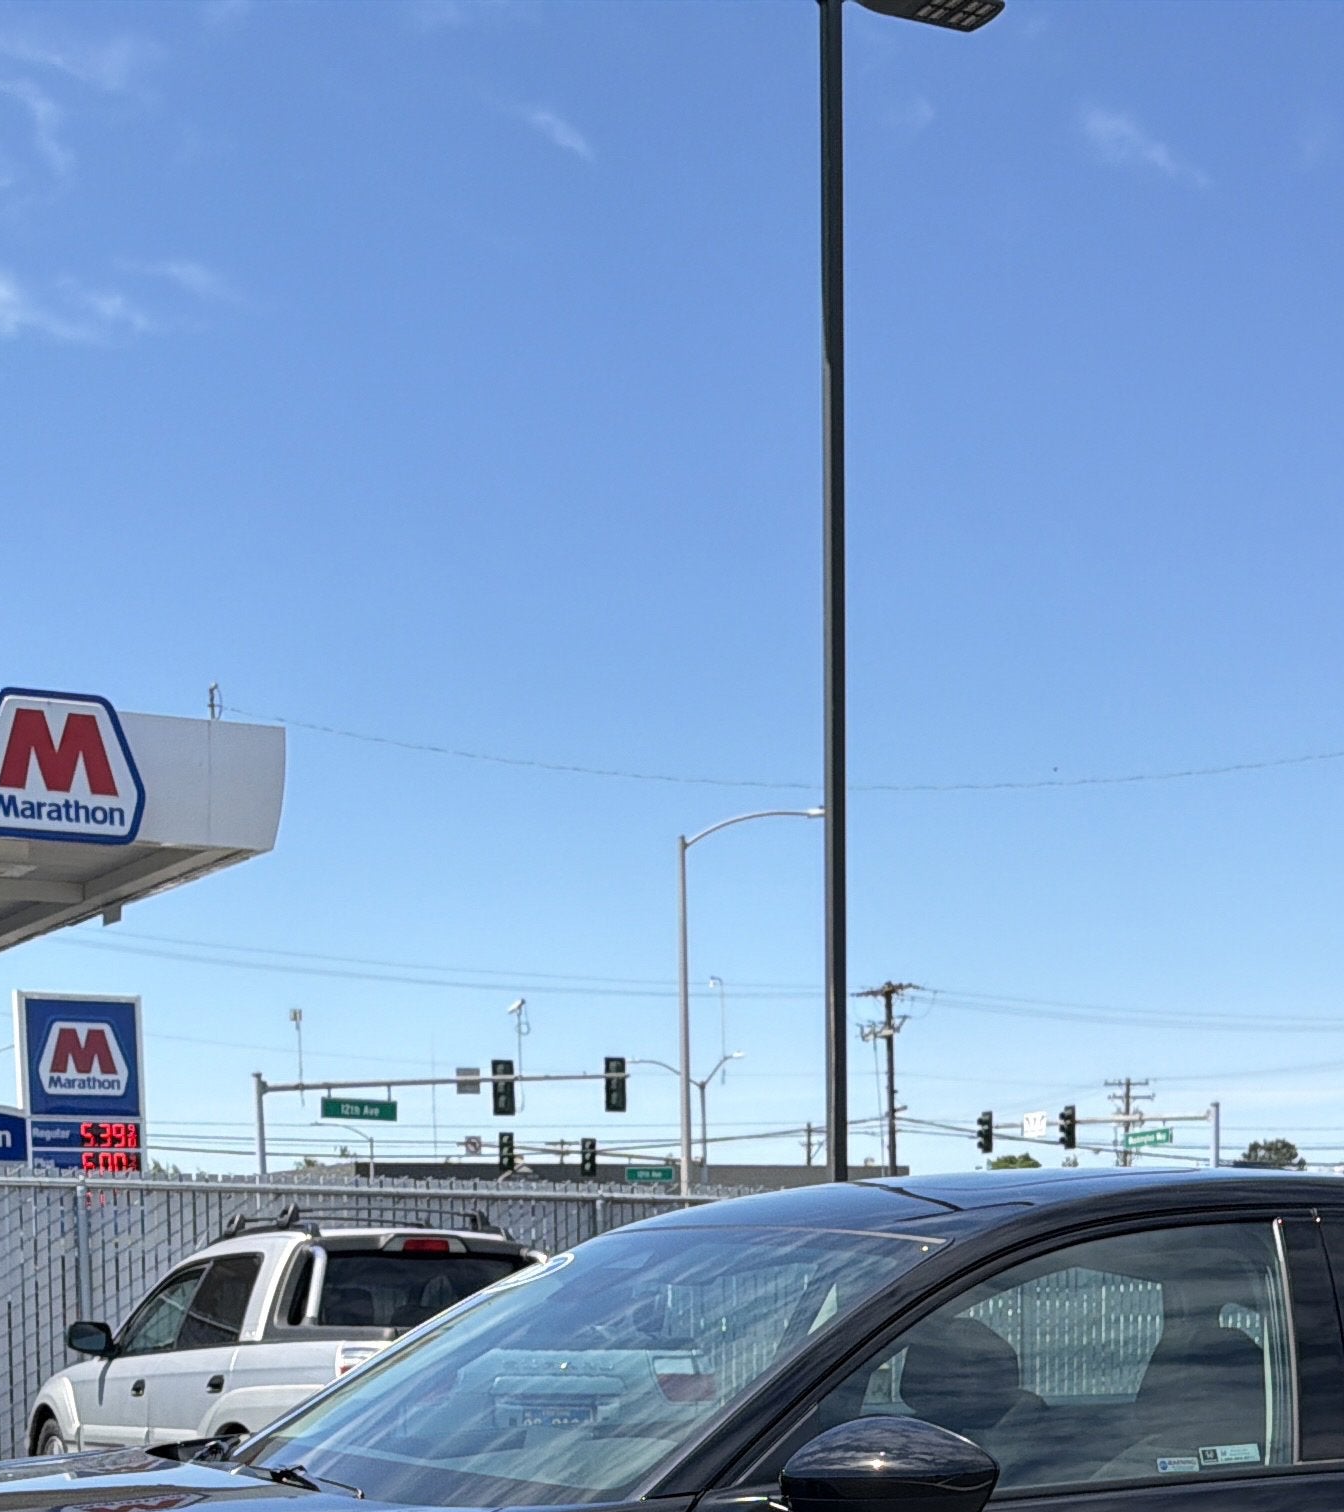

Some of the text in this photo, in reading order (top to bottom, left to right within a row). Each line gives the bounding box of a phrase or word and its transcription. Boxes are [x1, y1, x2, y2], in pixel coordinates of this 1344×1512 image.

[47, 1075, 121, 1091] Marathon
[340, 1103, 380, 1117] 12th Ave
